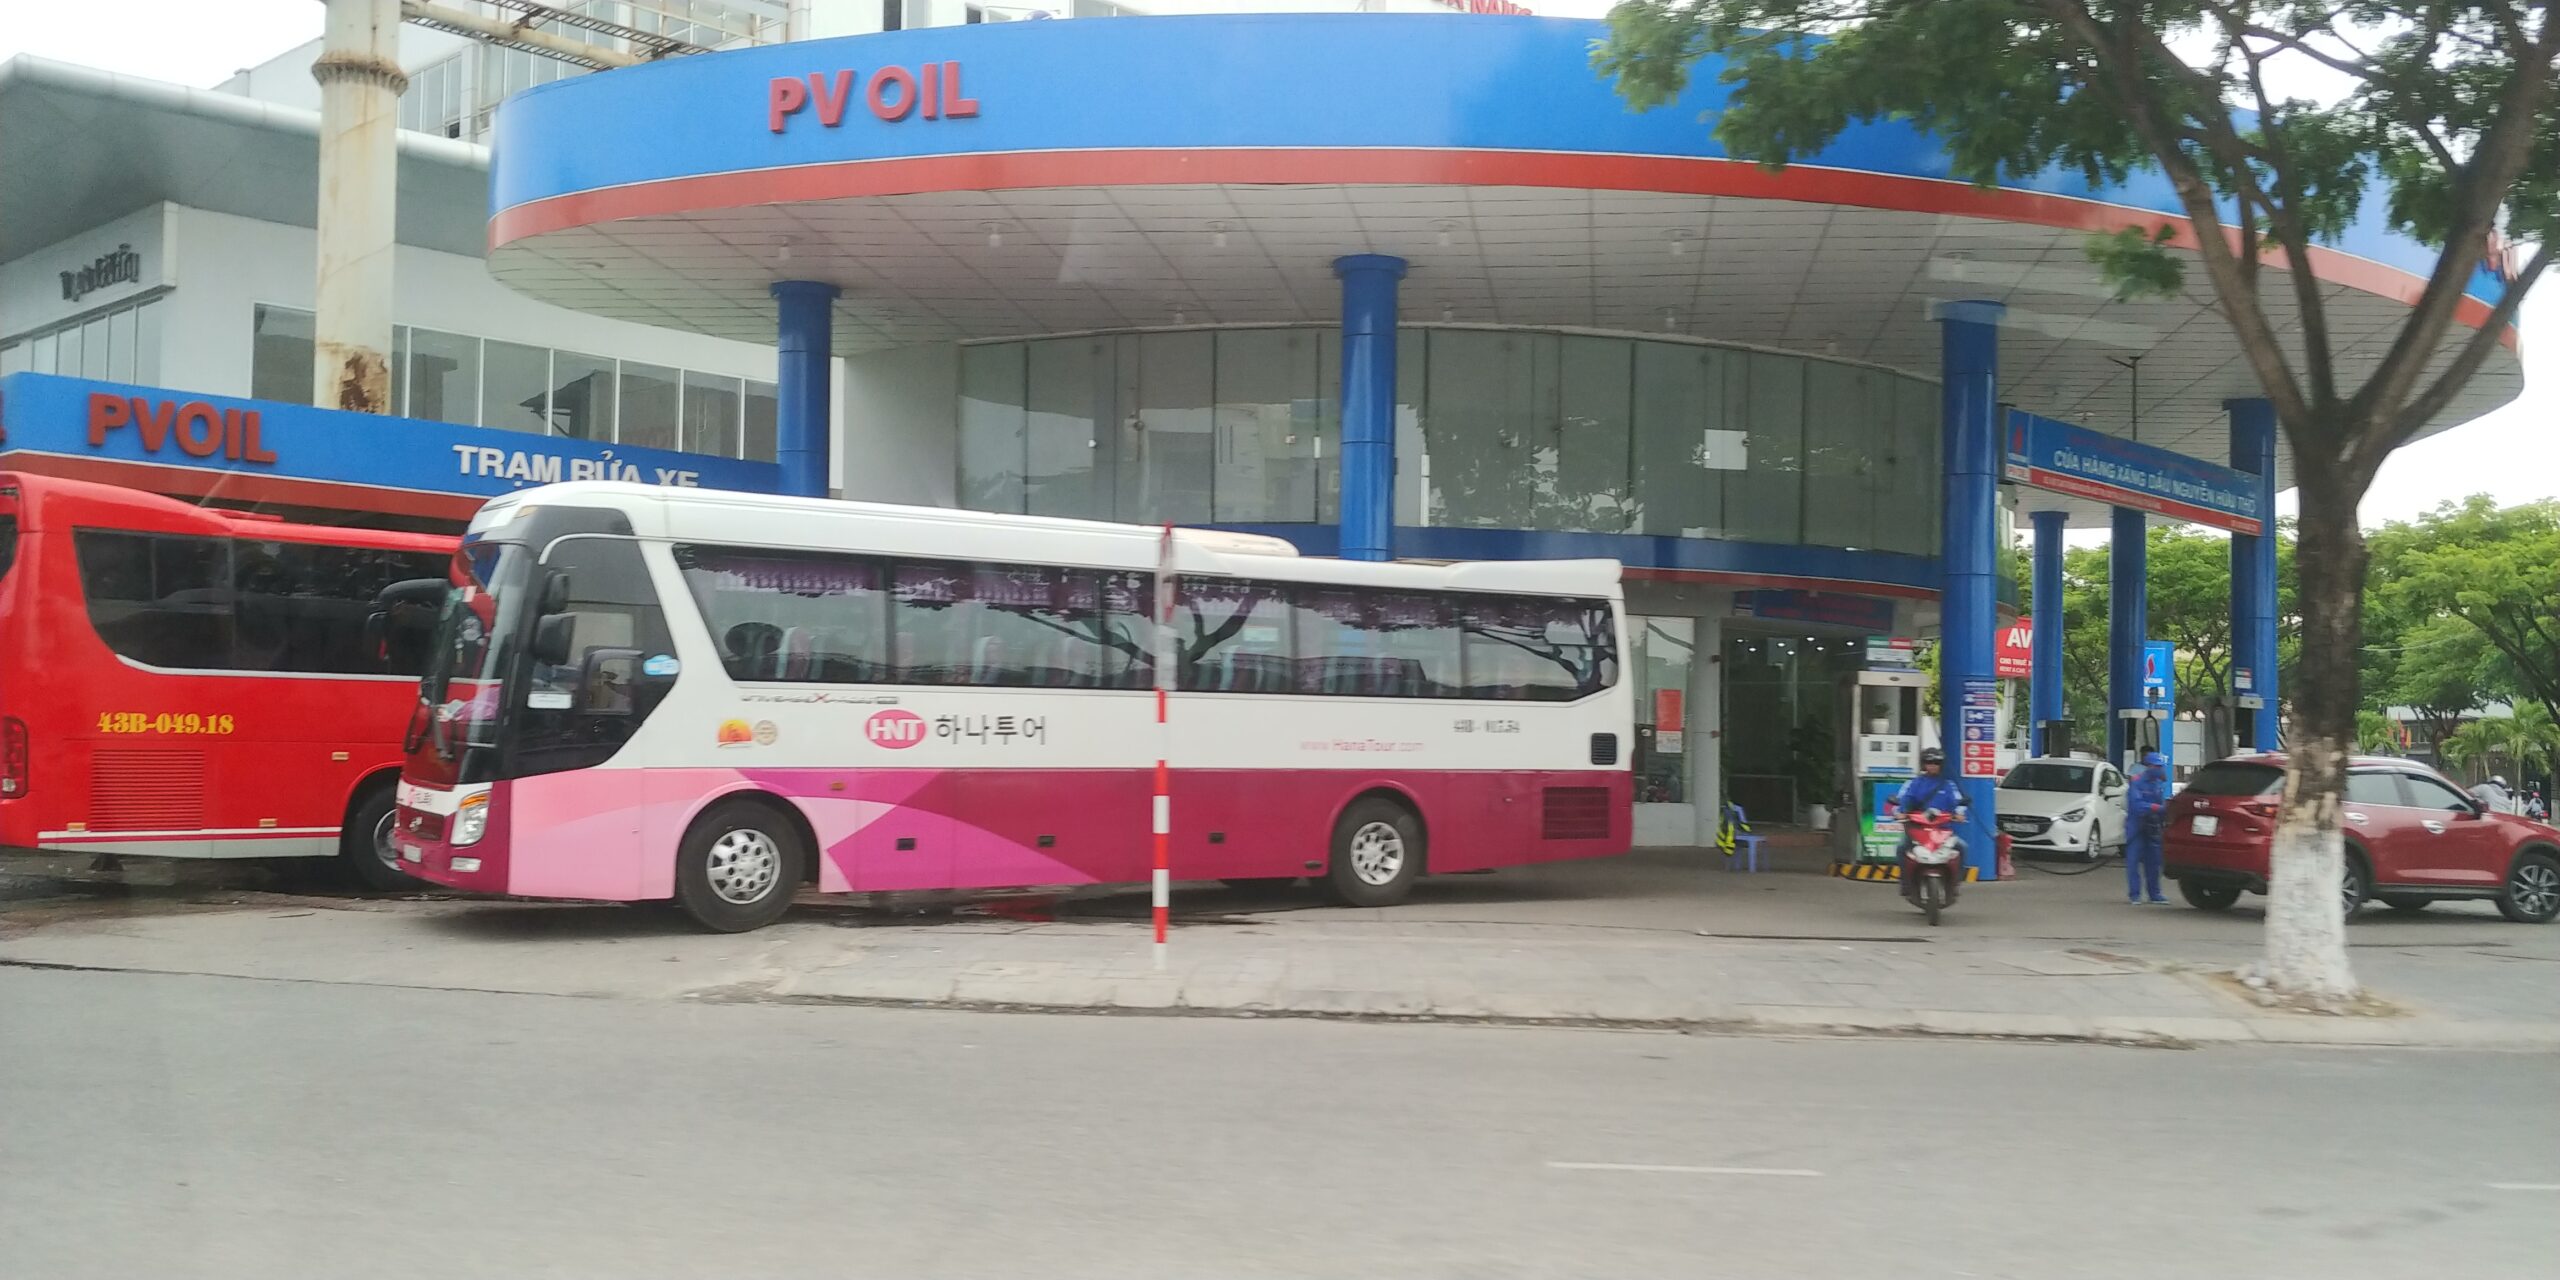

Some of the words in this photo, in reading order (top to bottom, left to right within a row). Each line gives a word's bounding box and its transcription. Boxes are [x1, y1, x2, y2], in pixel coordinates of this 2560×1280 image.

[88, 391, 278, 464] PVOIL
[452, 444, 562, 487] TRẠM
[97, 711, 235, 735] 43B-049.18
[868, 717, 923, 742] HNT
[935, 714, 1046, 746] 하나투어
